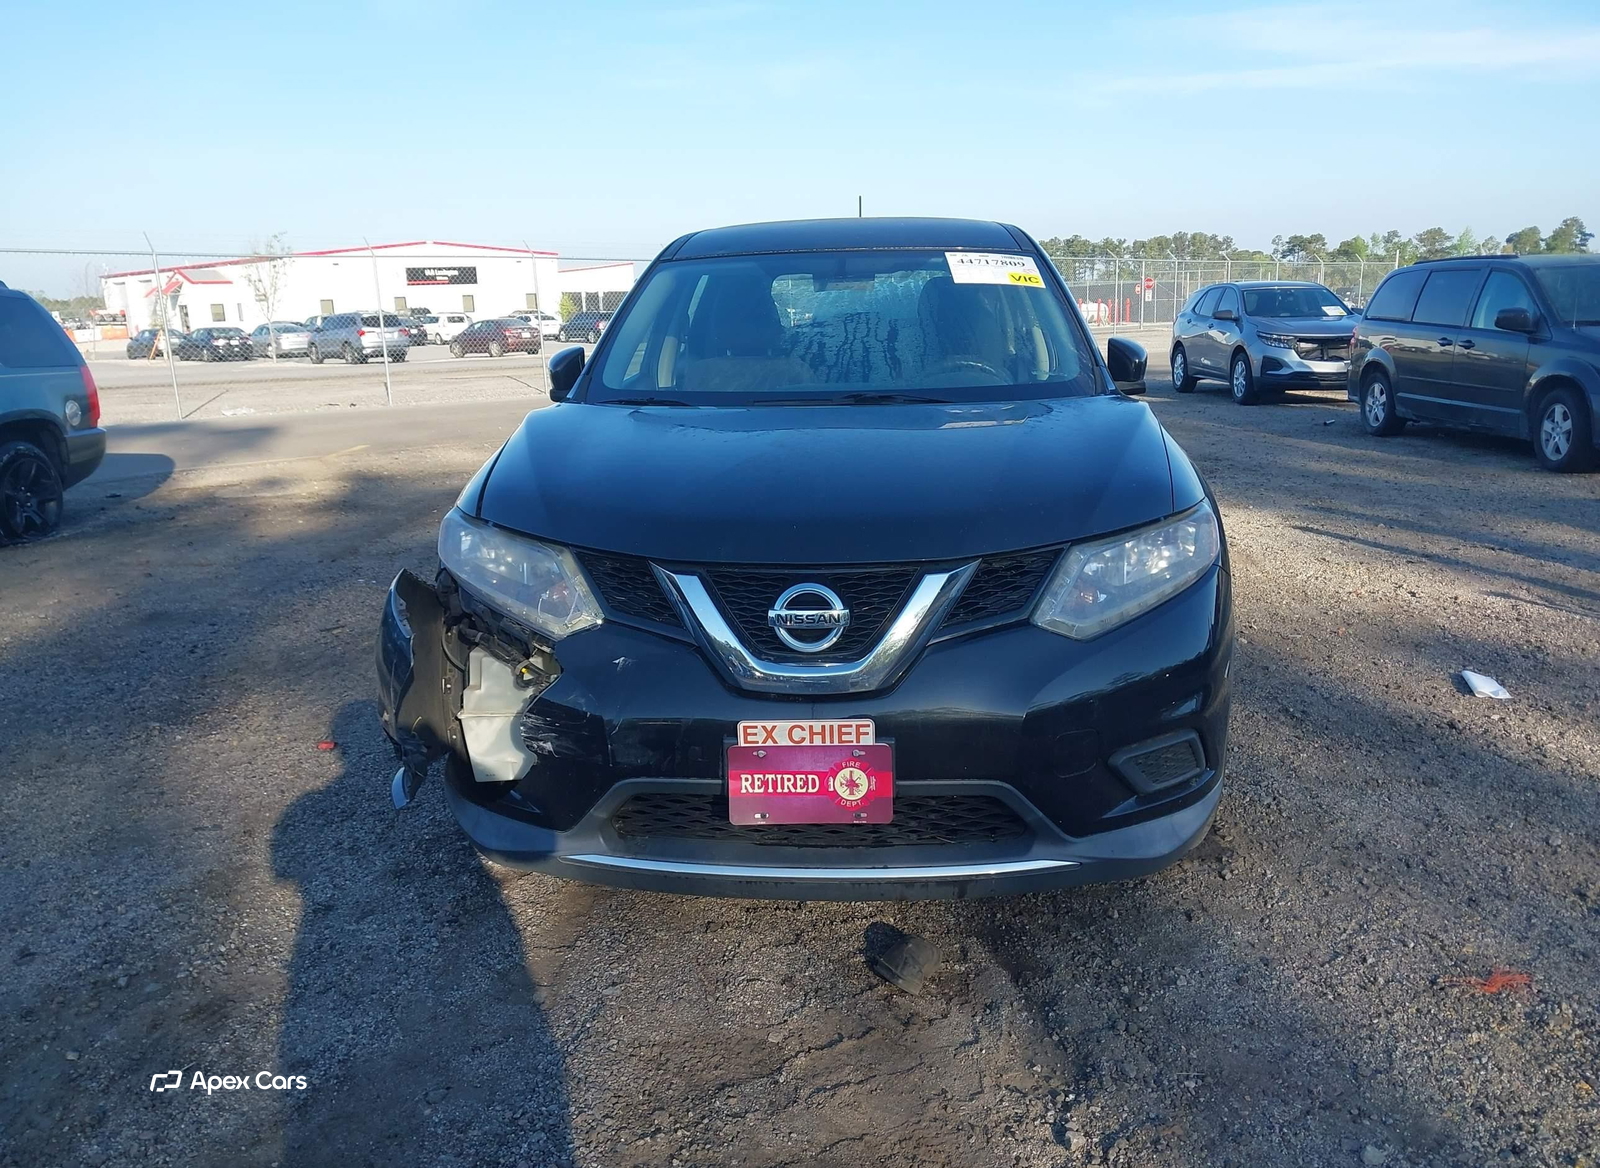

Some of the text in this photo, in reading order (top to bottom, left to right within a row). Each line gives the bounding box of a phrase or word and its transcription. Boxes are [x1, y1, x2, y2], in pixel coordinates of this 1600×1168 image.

[1010, 274, 1040, 284] VIC
[774, 613, 841, 624] NISSAN
[743, 724, 871, 745] EX CHIEF
[740, 774, 820, 794] RETIRED
